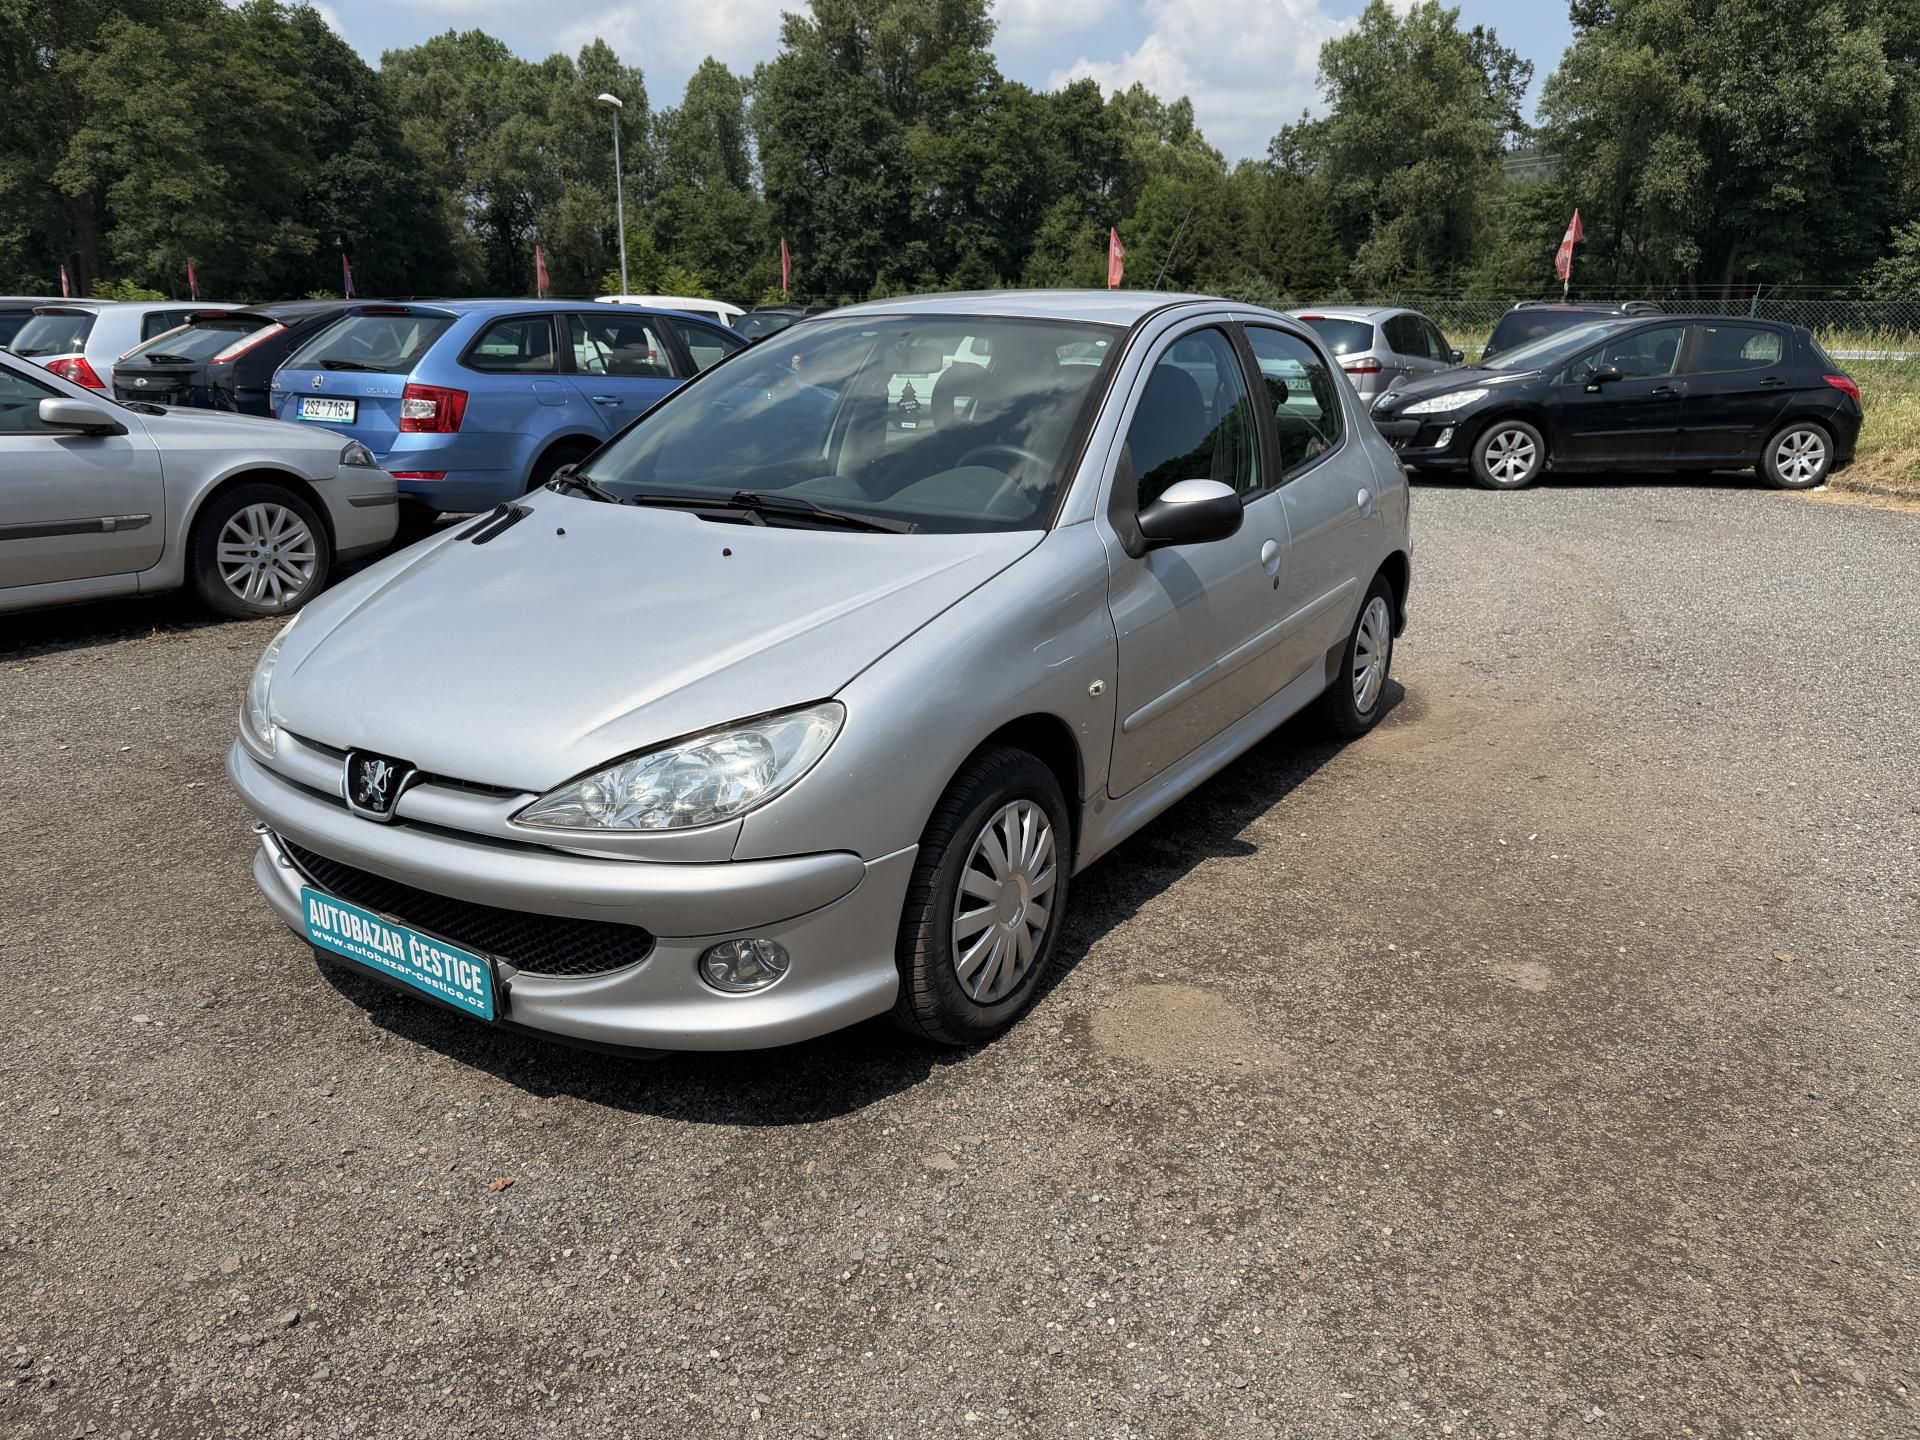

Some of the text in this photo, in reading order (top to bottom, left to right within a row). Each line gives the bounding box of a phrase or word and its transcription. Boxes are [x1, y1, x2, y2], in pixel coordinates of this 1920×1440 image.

[304, 399, 321, 415] 2SZ
[326, 400, 350, 417] 7164
[309, 898, 484, 996] AUTOBAZAR ČESTICE
[311, 928, 485, 1009] www.autobazar-cestice.cz
